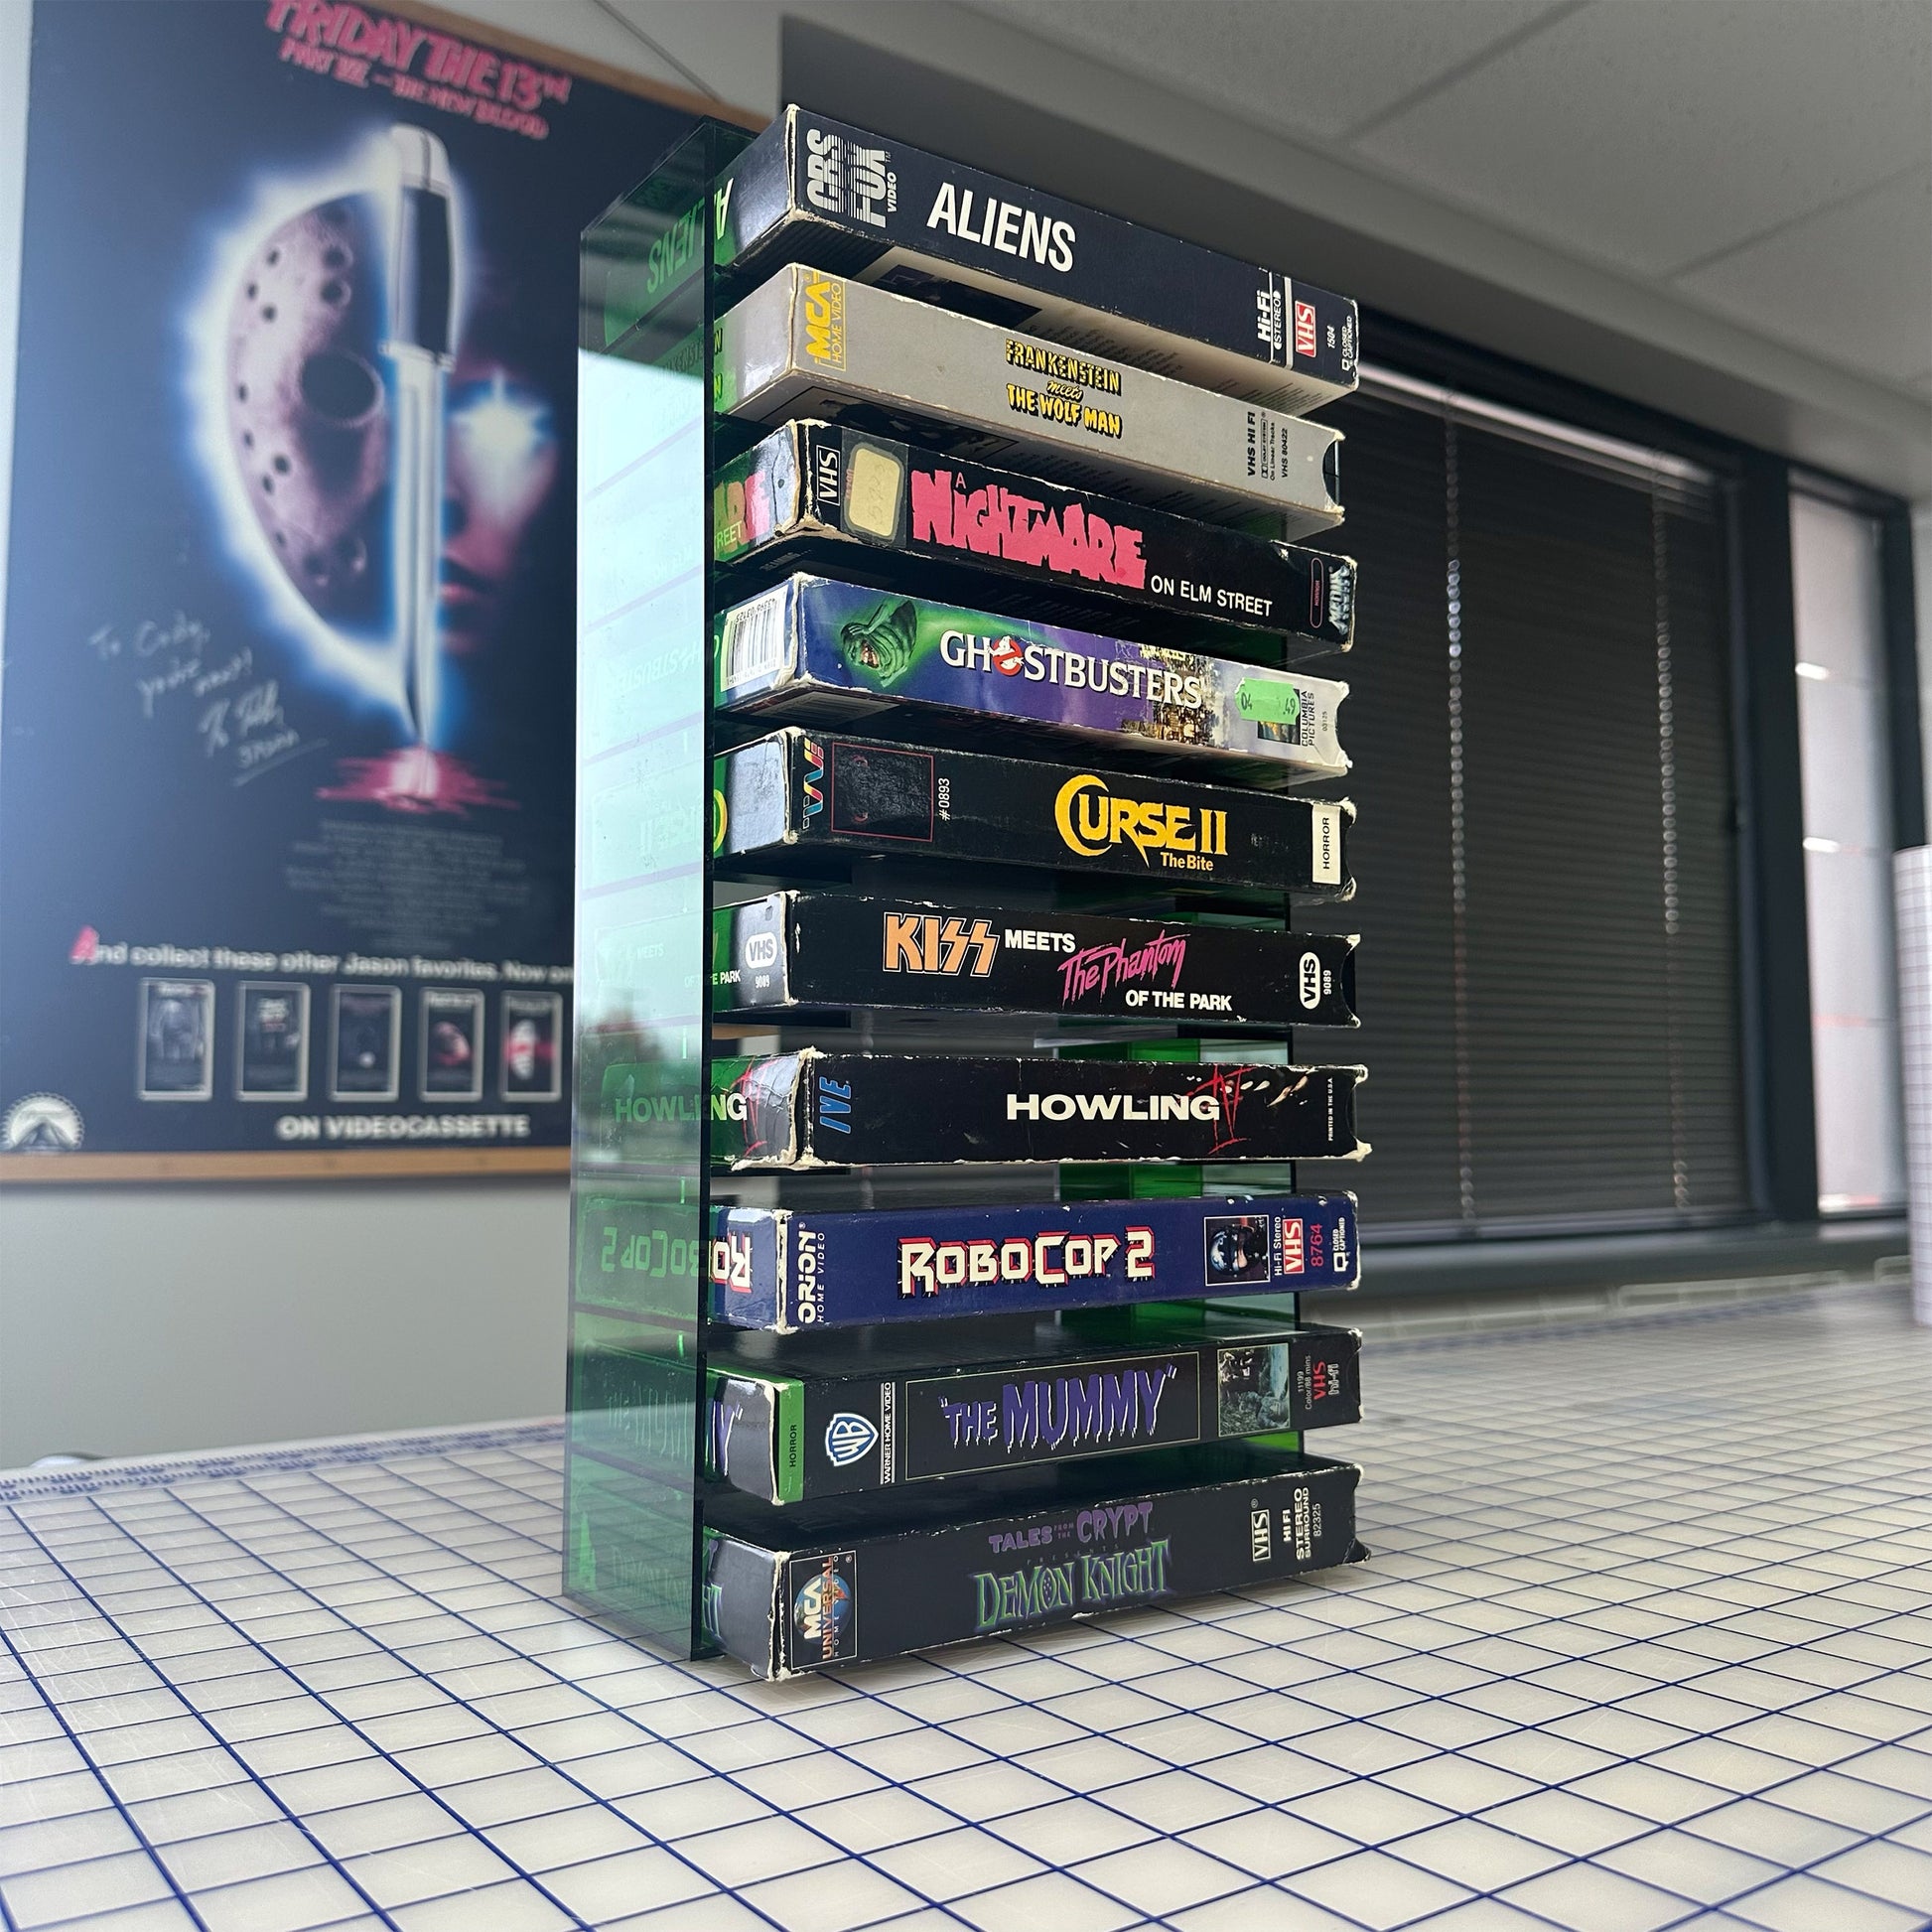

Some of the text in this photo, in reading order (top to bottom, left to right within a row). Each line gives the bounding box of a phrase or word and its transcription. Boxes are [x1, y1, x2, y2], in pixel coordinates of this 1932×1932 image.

[265, 0, 426, 70] FRIDAY
[424, 31, 499, 96] THE
[279, 38, 335, 73] PART
[844, 148, 889, 228] FOX
[887, 172, 898, 212] VIDEO
[925, 182, 1077, 273] ALIENS
[803, 279, 832, 363] MCA
[831, 282, 844, 362] HOME VIDEO
[1256, 290, 1272, 343] Hi-Fi
[1273, 297, 1282, 345] STEREO
[1297, 304, 1315, 352] VHS
[1327, 325, 1336, 348] 1504
[1006, 339, 1123, 396] FRANKENSTEIN
[1046, 379, 1084, 401] meets
[1007, 383, 1123, 440] THE WOLF MAN
[1248, 411, 1255, 425] FI
[1248, 428, 1255, 444] HI
[820, 451, 838, 499] VHS
[955, 472, 967, 489] A
[1151, 575, 1274, 618] ON ELM STREET
[938, 777, 950, 821] #0893
[1199, 807, 1228, 856] II
[1321, 816, 1330, 870] HORROR
[1161, 851, 1214, 872] The Bite
[69, 924, 128, 966] And
[130, 943, 209, 969] collect
[210, 946, 278, 972] these
[279, 949, 341, 975] other
[341, 952, 410, 978] Jason
[499, 959, 546, 985] Now
[749, 938, 773, 961] VHS
[882, 910, 1077, 979] KISS MEETS
[720, 969, 741, 985] PARK
[1057, 929, 1192, 1010] The Phantom
[1303, 959, 1316, 1003] VHS
[1322, 969, 1331, 995] 9089
[1126, 989, 1233, 1012] OF THE PARK
[277, 1114, 531, 1141] ON VIDEOCASSETTE
[819, 1075, 852, 1135] IVE
[1007, 1093, 1220, 1121] HOWLING
[1124, 1225, 1156, 1281] 2
[1273, 1216, 1282, 1249] Stereo
[1285, 1221, 1304, 1273] VHS
[1310, 1223, 1323, 1267] 8764
[798, 1230, 817, 1324] ORION
[816, 1232, 825, 1323] HOME VIDEO
[1312, 1360, 1326, 1400] VHS
[988, 1525, 1053, 1553] TALES
[1076, 1501, 1153, 1543] CRYPT
[1254, 1511, 1269, 1559] VHS
[1283, 1508, 1291, 1542] HI FI
[1294, 1487, 1304, 1561] STEREO
[1312, 1503, 1321, 1537] 82325
[973, 1538, 1172, 1628] DEMON KNIGHT
[803, 1578, 822, 1639] MCA
[822, 1556, 833, 1660] UNIVERSAL
